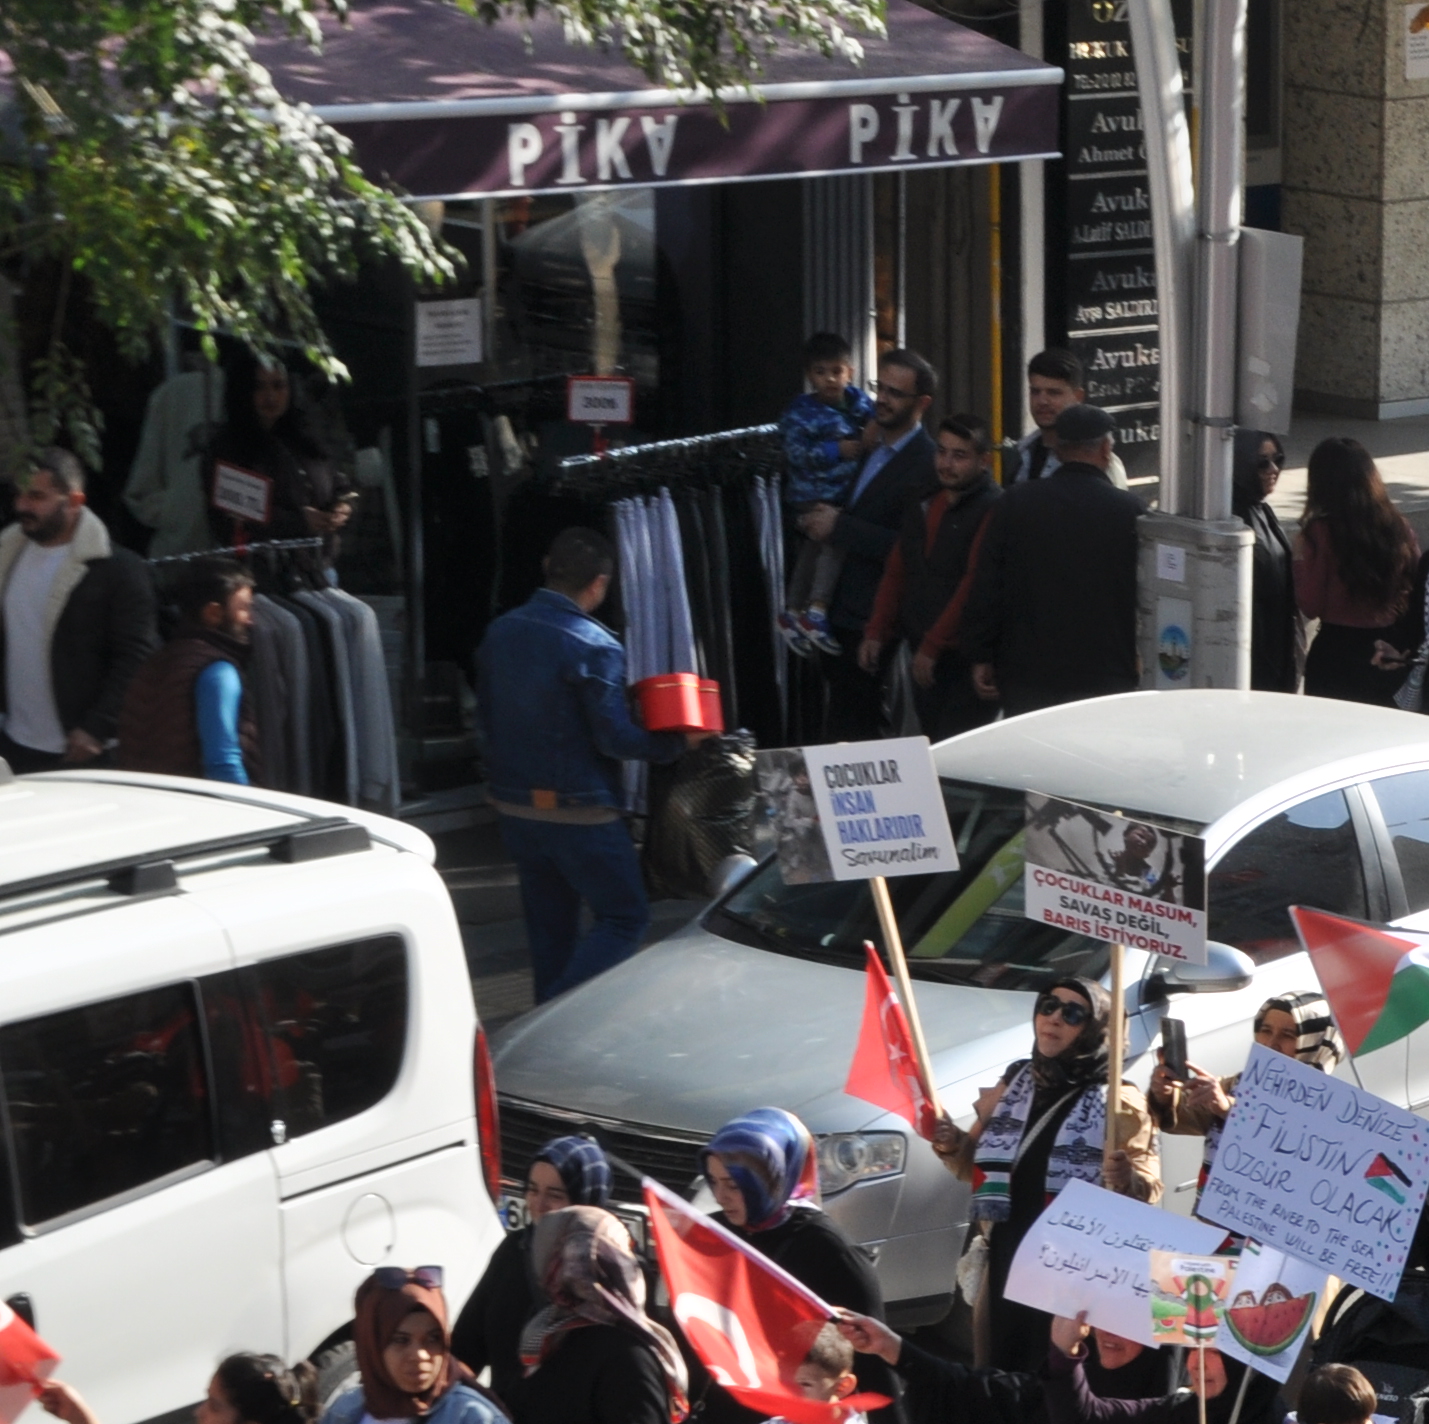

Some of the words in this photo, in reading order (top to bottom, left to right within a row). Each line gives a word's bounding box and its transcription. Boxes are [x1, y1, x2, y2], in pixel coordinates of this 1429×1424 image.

[1078, 146, 1134, 163] Ahmet
[1091, 187, 1149, 213] Avuk
[1090, 266, 1157, 292] Avuka
[1090, 343, 1160, 371] Avuka
[830, 789, 877, 817] İNSAN
[836, 813, 926, 845] HAKLARIDIR
[1033, 869, 1124, 907] ÇOCUKLAR
[1127, 896, 1199, 928] MASUM,
[1060, 895, 1112, 925] SAVAŞ
[1115, 911, 1171, 939] DEĞİL,
[1095, 919, 1188, 961] İSTİYORUZ.
[1336, 1089, 1418, 1142] DENİZE
[1252, 1102, 1374, 1176] FİLİSTİN
[1207, 1177, 1240, 1202] FROM
[1246, 1191, 1266, 1211] THE
[1270, 1203, 1303, 1229] RIVER
[1305, 1220, 1320, 1235] TO
[1326, 1227, 1349, 1248] THE
[1310, 1178, 1408, 1244] OLACAK
[1217, 1199, 1277, 1237] PALESTINE
[1285, 1231, 1314, 1255] WILL
[1319, 1248, 1339, 1266] BE
[1342, 1258, 1394, 1294] FREE!!
